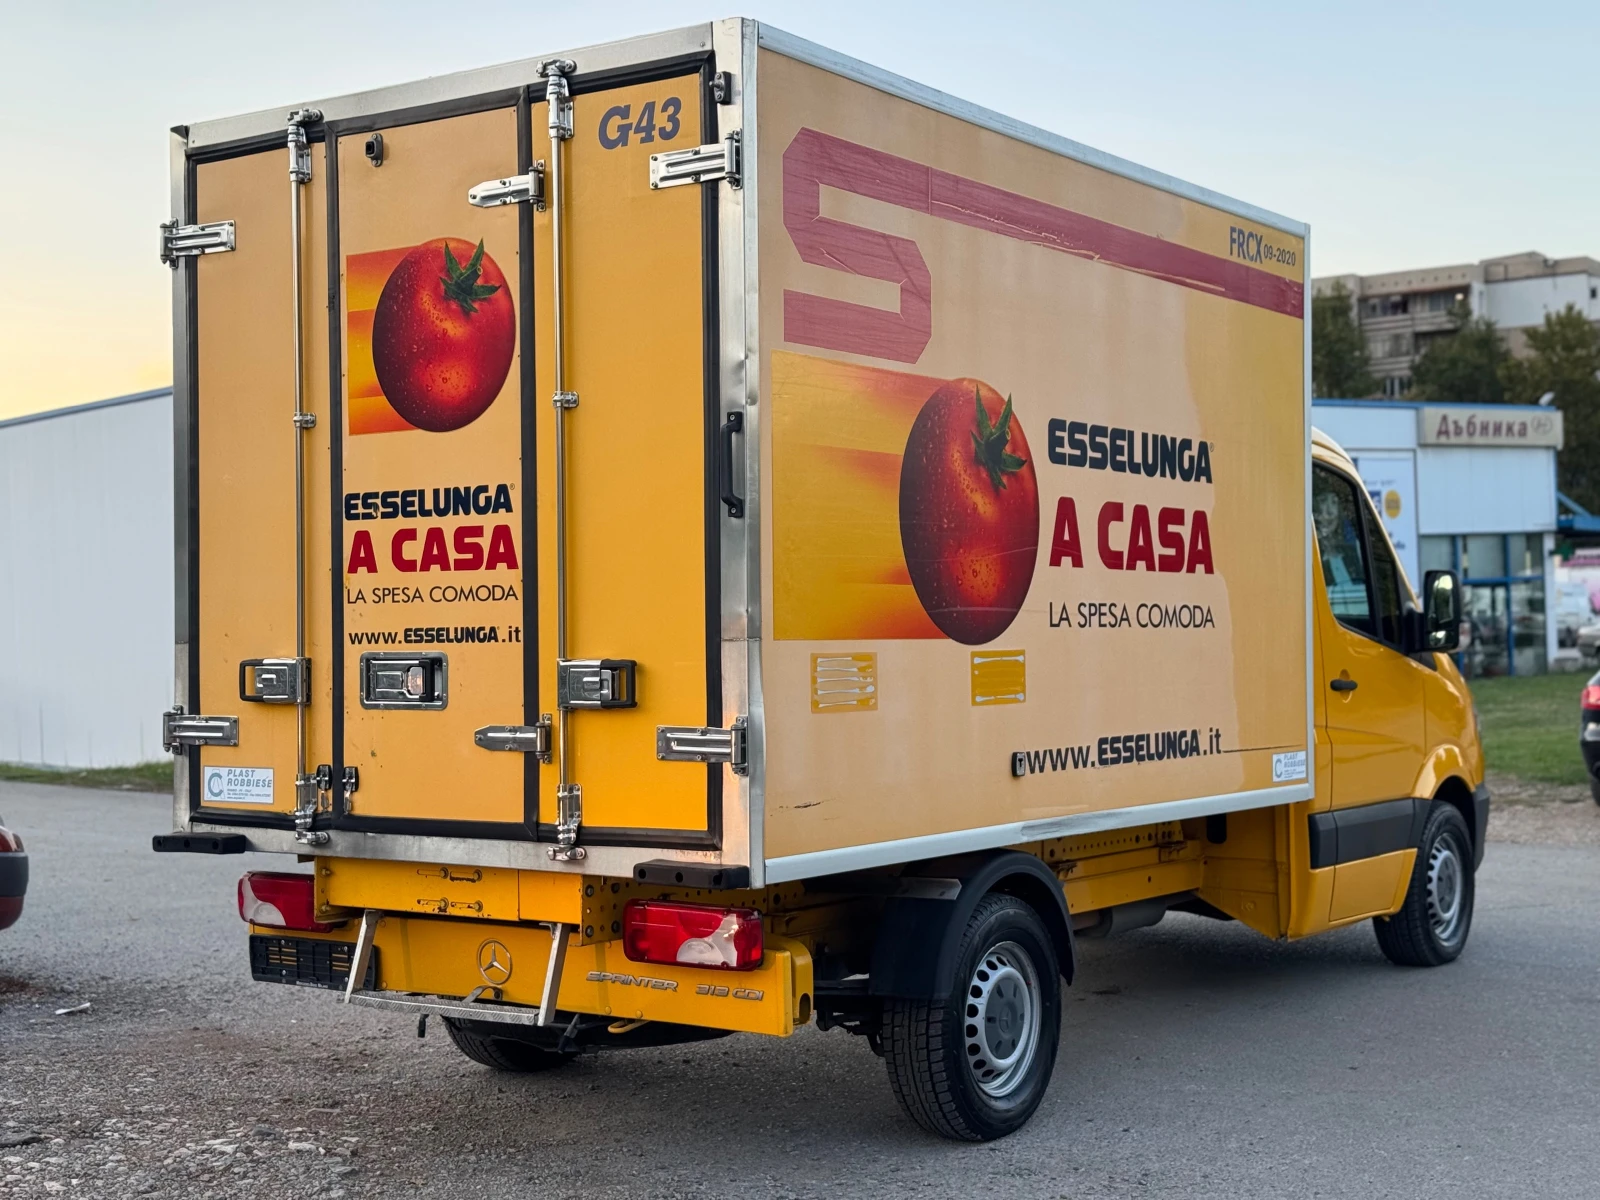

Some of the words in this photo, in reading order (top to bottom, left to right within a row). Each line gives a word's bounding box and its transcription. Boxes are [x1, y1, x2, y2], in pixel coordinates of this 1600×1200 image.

[598, 96, 682, 150] G43
[1229, 225, 1263, 264] FRCX
[1264, 243, 1296, 267] 09-2020
[1436, 413, 1528, 440] Дъбника
[347, 529, 378, 574] A
[391, 524, 519, 573] CASA
[1049, 496, 1084, 568] A
[1097, 501, 1214, 575] CASA
[347, 588, 367, 604] LA
[372, 586, 424, 604] SPESA
[429, 584, 519, 603] COMODA
[1049, 601, 1072, 628] LA
[1077, 602, 1132, 628] SPESA
[1136, 602, 1215, 629] COMODA
[226, 768, 256, 778] PLAST
[226, 777, 273, 788] ROBBIESE
[586, 970, 679, 993] SPRINTER
[695, 984, 729, 997] 313
[732, 988, 765, 1002] CDI
